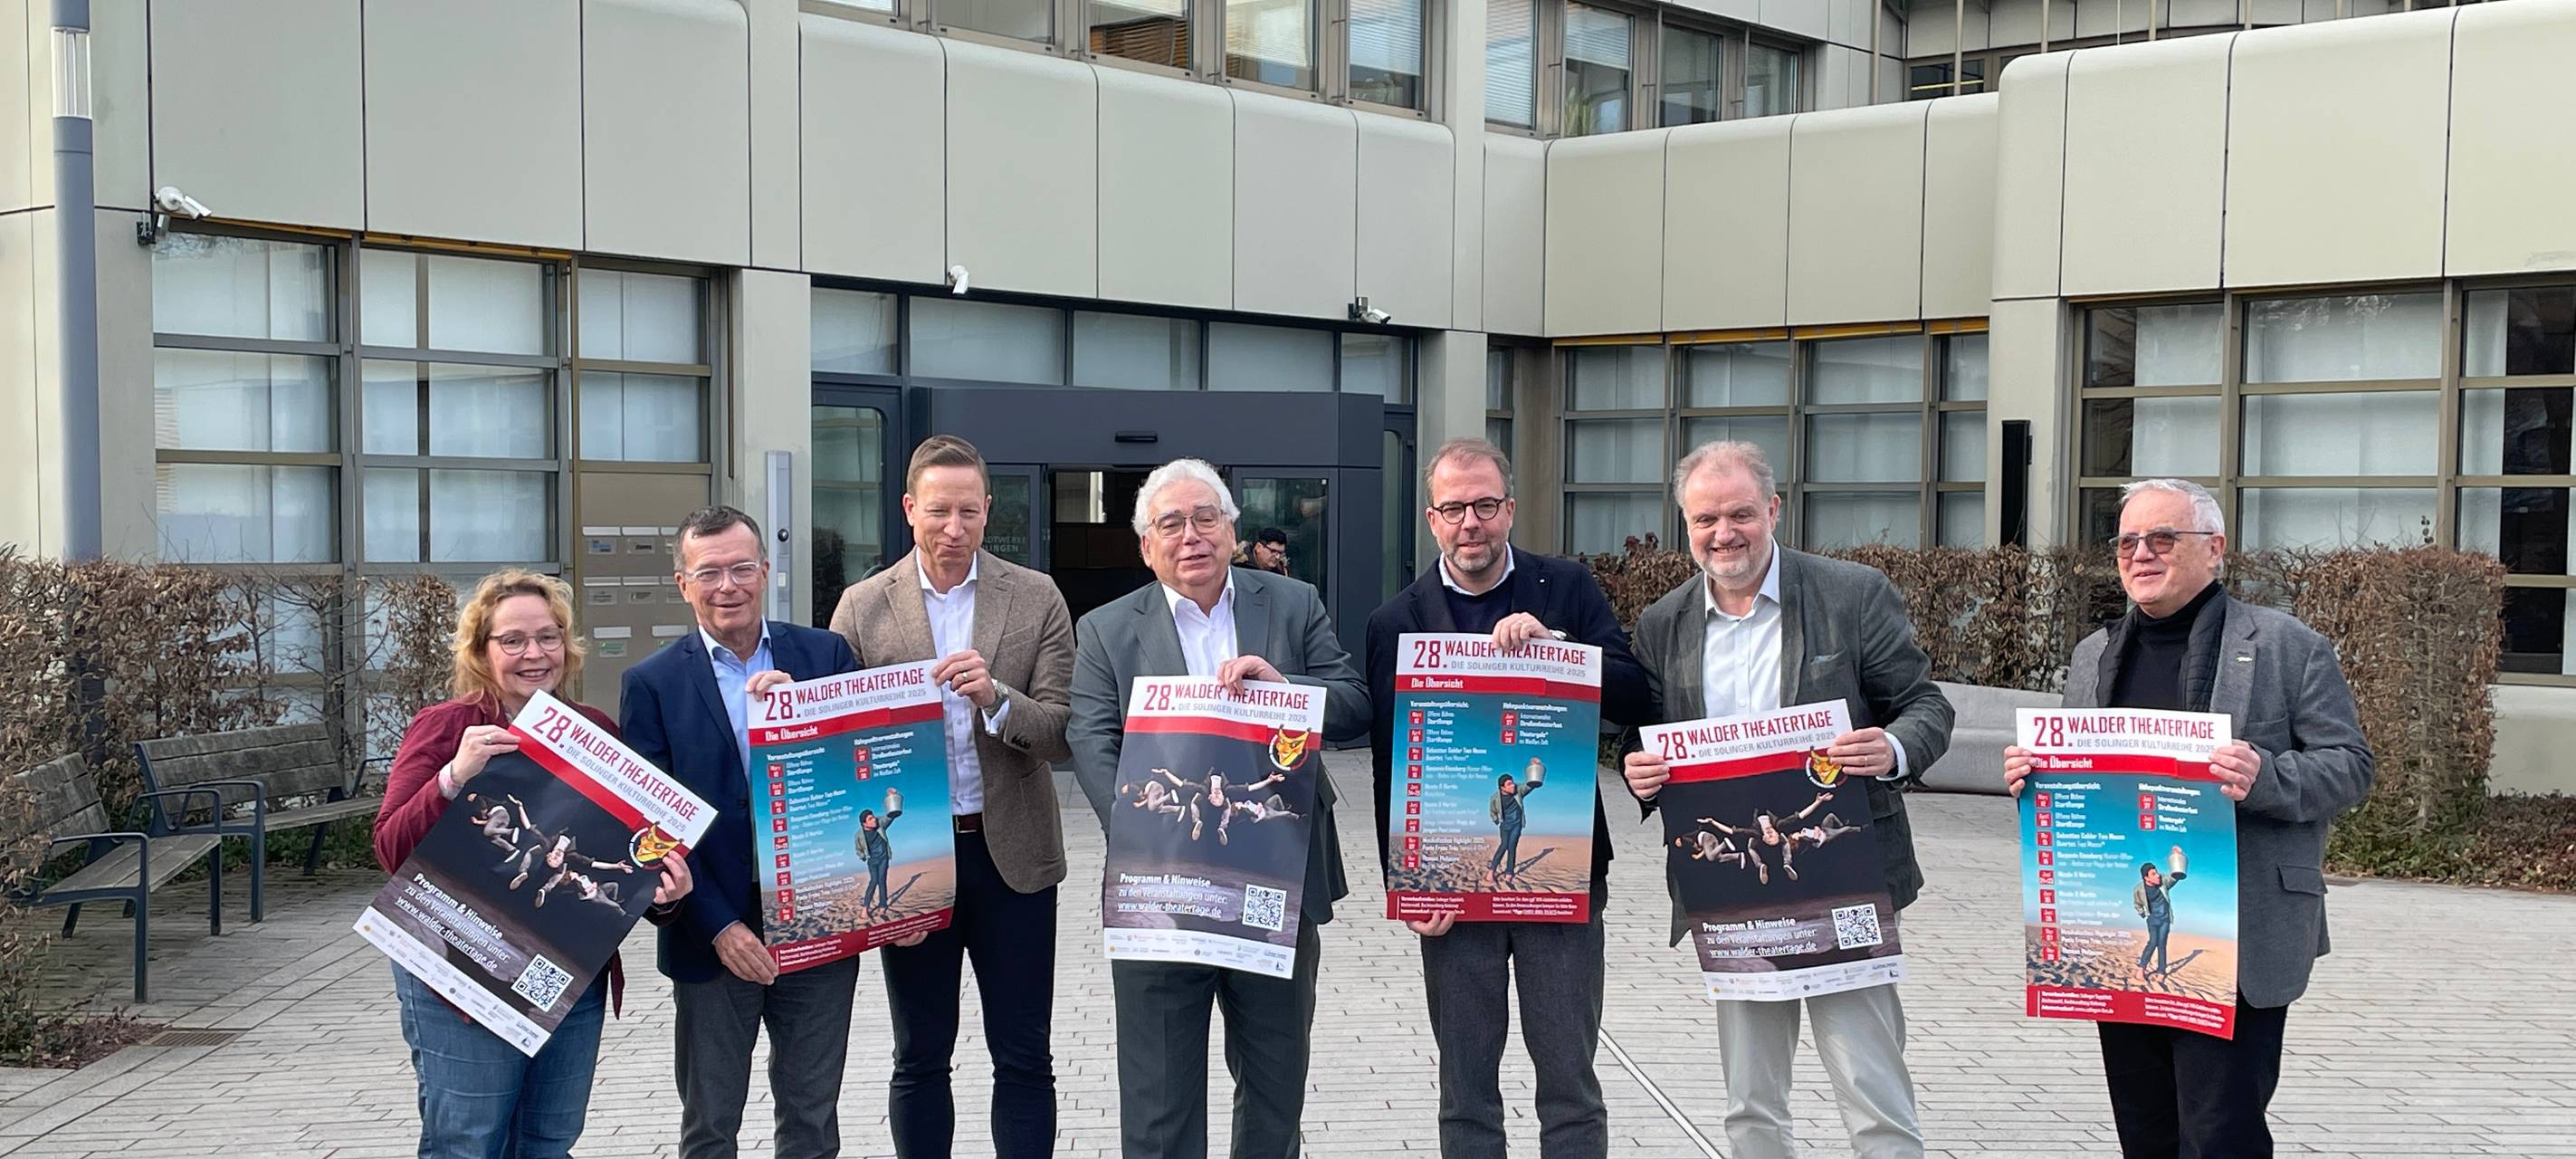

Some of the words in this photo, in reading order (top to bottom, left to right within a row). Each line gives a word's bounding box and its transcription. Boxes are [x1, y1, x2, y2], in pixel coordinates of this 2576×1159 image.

[1413, 640, 1447, 668] 28.
[1445, 640, 1496, 657] WALDER
[1451, 660, 1465, 669] DIE
[1467, 661, 1508, 672] SOLINGER
[1510, 663, 1564, 675] KULTURREIHE
[1566, 667, 1586, 677] 2025
[764, 691, 801, 722] 28.
[796, 681, 842, 705] WALDER
[844, 667, 925, 696] THEATERTAGE
[1411, 677, 1424, 689] Die
[1426, 676, 1464, 689] Übersicht
[804, 705, 817, 717] DIE
[818, 700, 854, 715] SOLINGER
[855, 691, 906, 707] KULTURREIHE
[907, 687, 927, 699] 2025
[1143, 684, 1176, 711] 28.
[1176, 684, 1222, 700] WALDER
[1178, 702, 1191, 711] DIE
[1193, 703, 1232, 715] SOLINGER
[1234, 707, 1286, 721] KULTURREIHE
[1288, 712, 1308, 723] 2025
[765, 730, 779, 742] Die
[780, 726, 818, 741] Übersicht
[1657, 731, 1696, 761] 28.
[1687, 723, 1740, 746] WALDER
[1741, 710, 1833, 737] THEATERTAGE
[2033, 716, 2073, 747] 28.
[2067, 716, 2126, 733] WALDER
[2129, 716, 2215, 739] THEATERTAGE
[1698, 749, 1712, 758] DIE
[1714, 743, 1755, 755] SOLINGER
[1756, 734, 1816, 751] KULTURREIHE
[1816, 731, 1837, 742] 2025
[2076, 738, 2092, 748] DIE
[2094, 739, 2140, 748] SOLINGER
[2142, 741, 2193, 752] KULTURREIHE
[2195, 743, 2216, 753] 2025
[531, 705, 572, 749] 28.
[570, 723, 621, 767] WALDER
[617, 757, 700, 822] THEATERTAGE
[2049, 755, 2094, 769] Übersicht
[567, 745, 580, 760] DIE
[579, 754, 619, 786] SOLINGER
[617, 780, 669, 819] KULTURREIHE
[667, 815, 688, 833] 2025
[1120, 873, 1162, 886] Programm
[1162, 875, 1169, 885] &
[1171, 874, 1211, 887] Hinweise
[1118, 888, 1128, 897] zu
[1128, 887, 1142, 897] den
[1142, 887, 1203, 901] Veranstaltungen
[405, 886, 415, 896] zu
[415, 891, 430, 905] den
[430, 899, 487, 947] Veranstaltungen
[414, 873, 459, 908] Programm
[456, 904, 467, 915] &
[464, 908, 503, 940] Hinweise
[1117, 901, 1223, 918] www.walder-theatertage.de
[395, 896, 498, 972] www.walder-theatertage.de
[1703, 922, 1746, 934] Programm
[1747, 920, 1754, 930] &
[1755, 916, 1796, 929] Hinweise
[1709, 941, 1818, 958] www.walder-theatertage.de
[1716, 935, 1730, 944] den
[1730, 931, 1792, 944] Veranstaltungen
